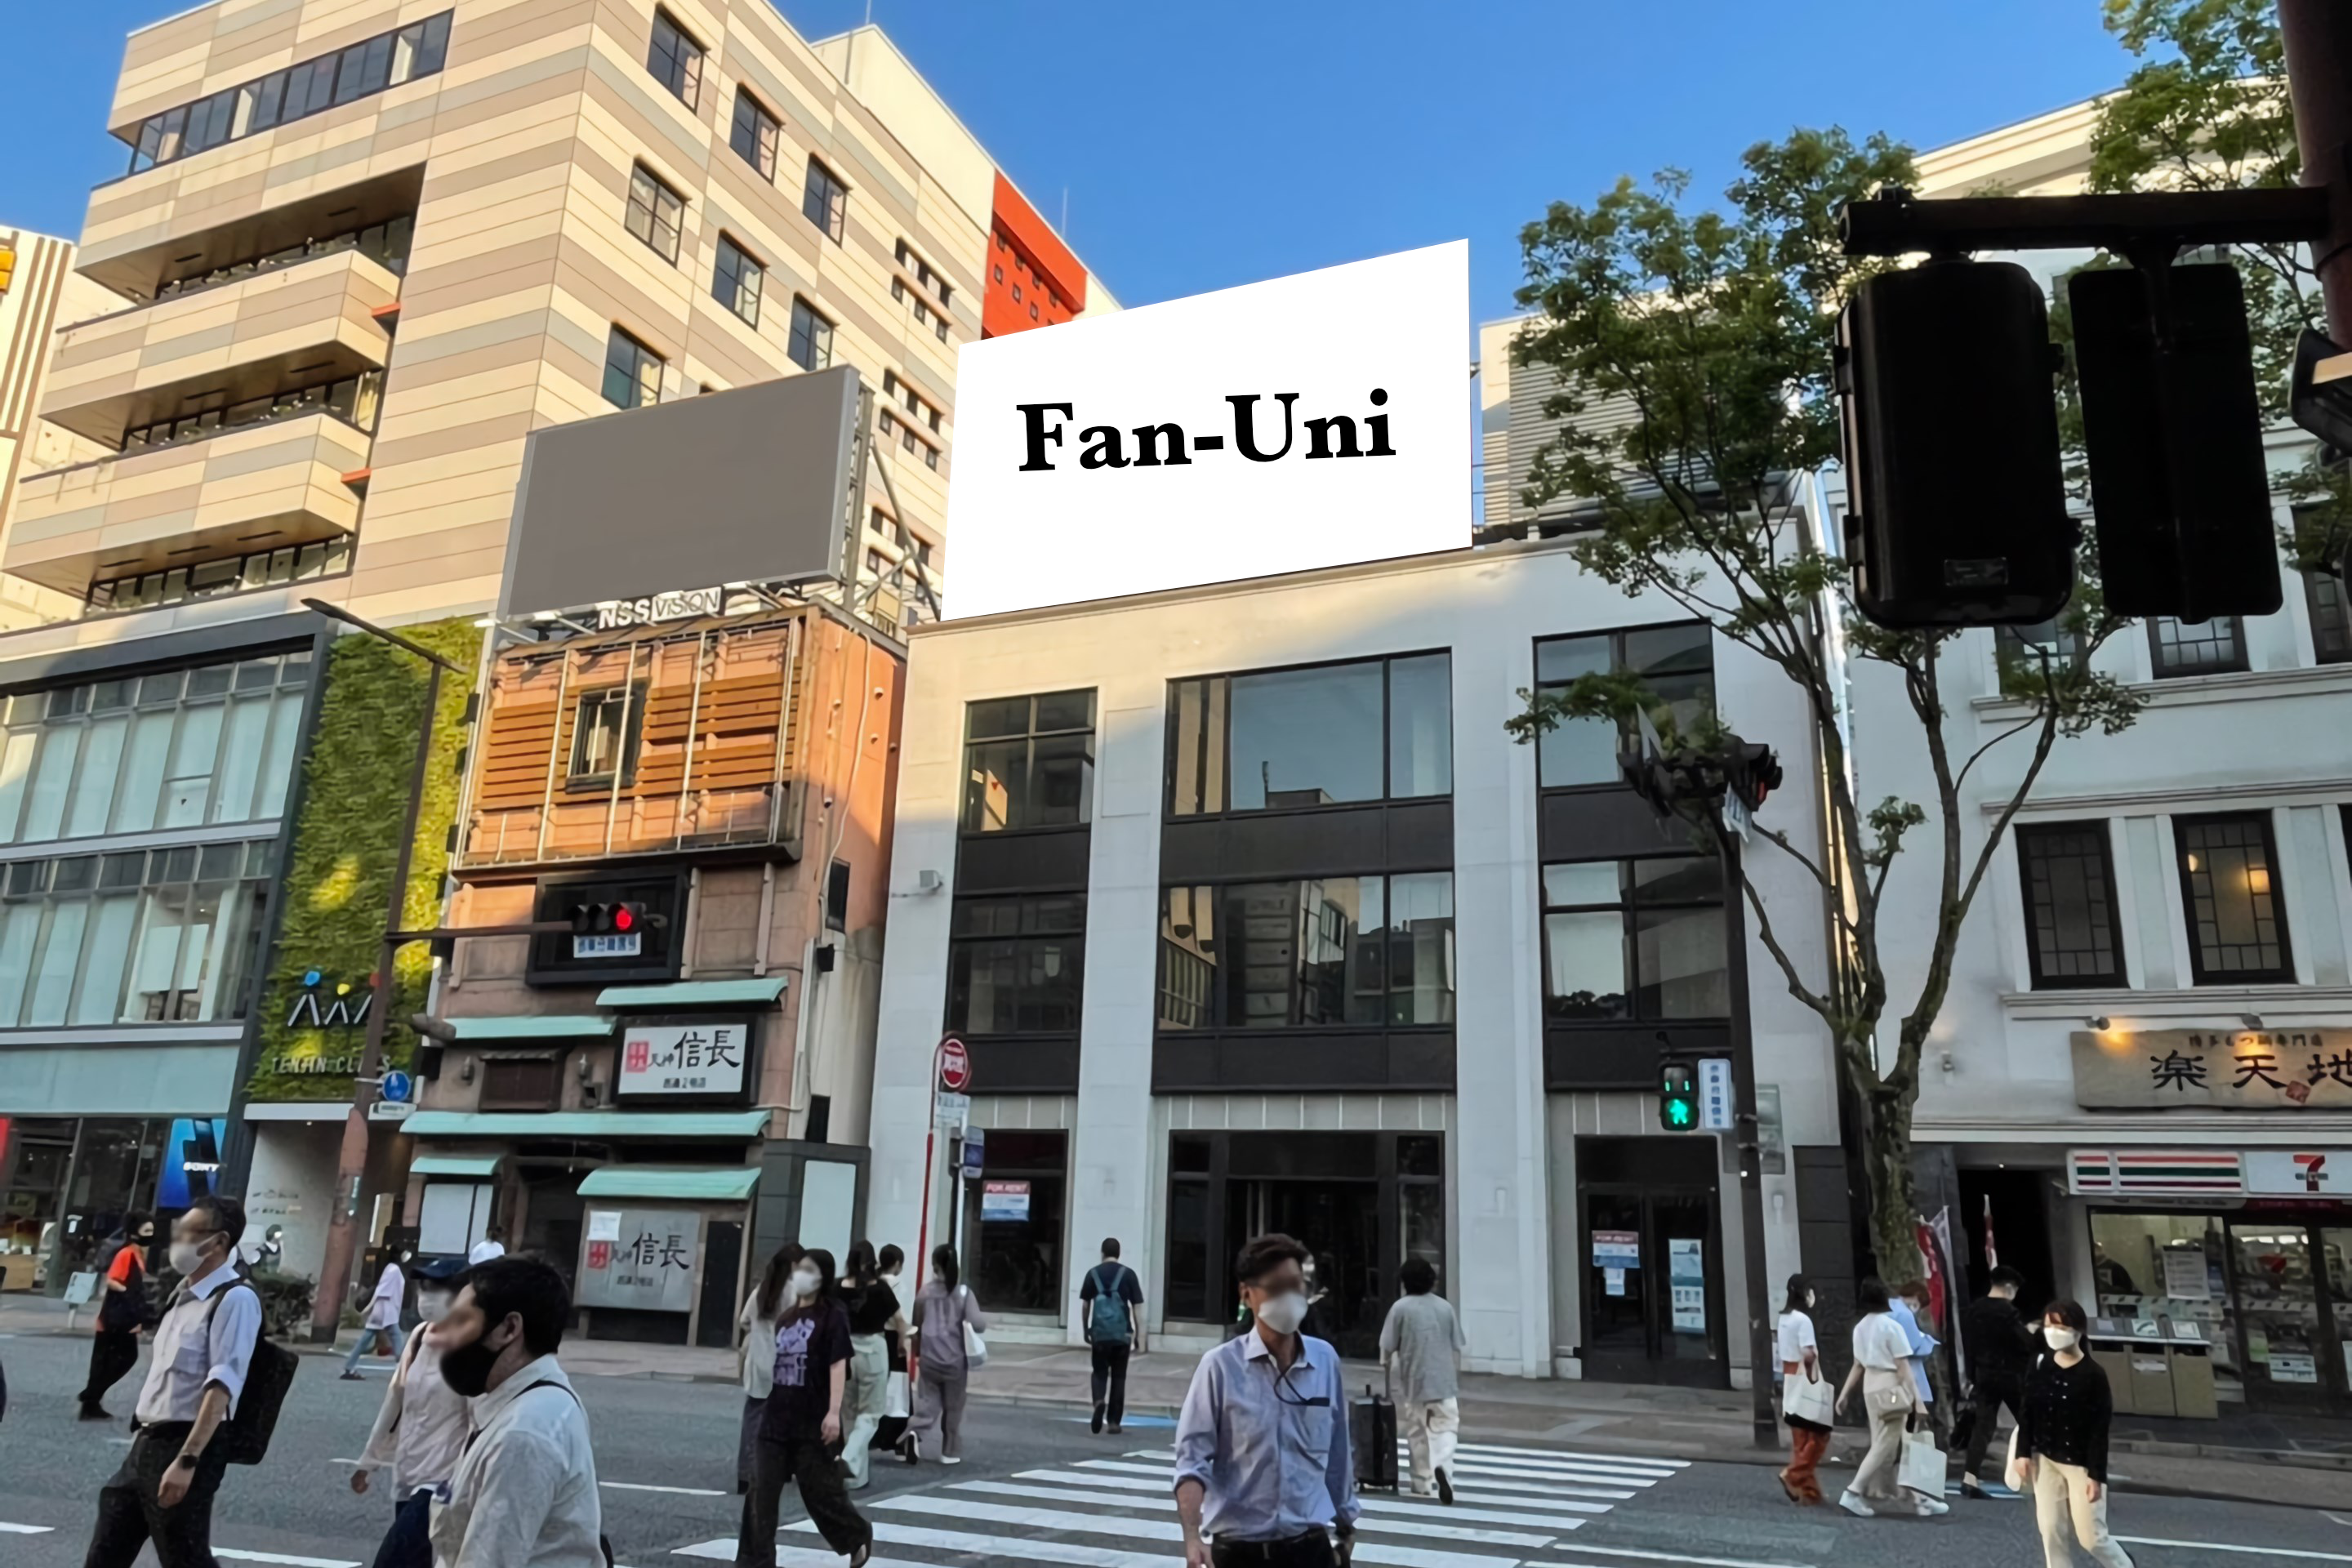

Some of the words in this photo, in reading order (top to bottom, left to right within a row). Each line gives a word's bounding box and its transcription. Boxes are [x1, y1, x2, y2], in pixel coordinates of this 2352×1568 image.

[1016, 388, 1396, 472] Fan-Uni
[599, 598, 651, 629] NSS
[336, 1055, 390, 1073] CLS
[674, 1030, 741, 1069] 信長
[2150, 1049, 2352, 1092] 楽天地
[632, 1232, 690, 1270] 信長
